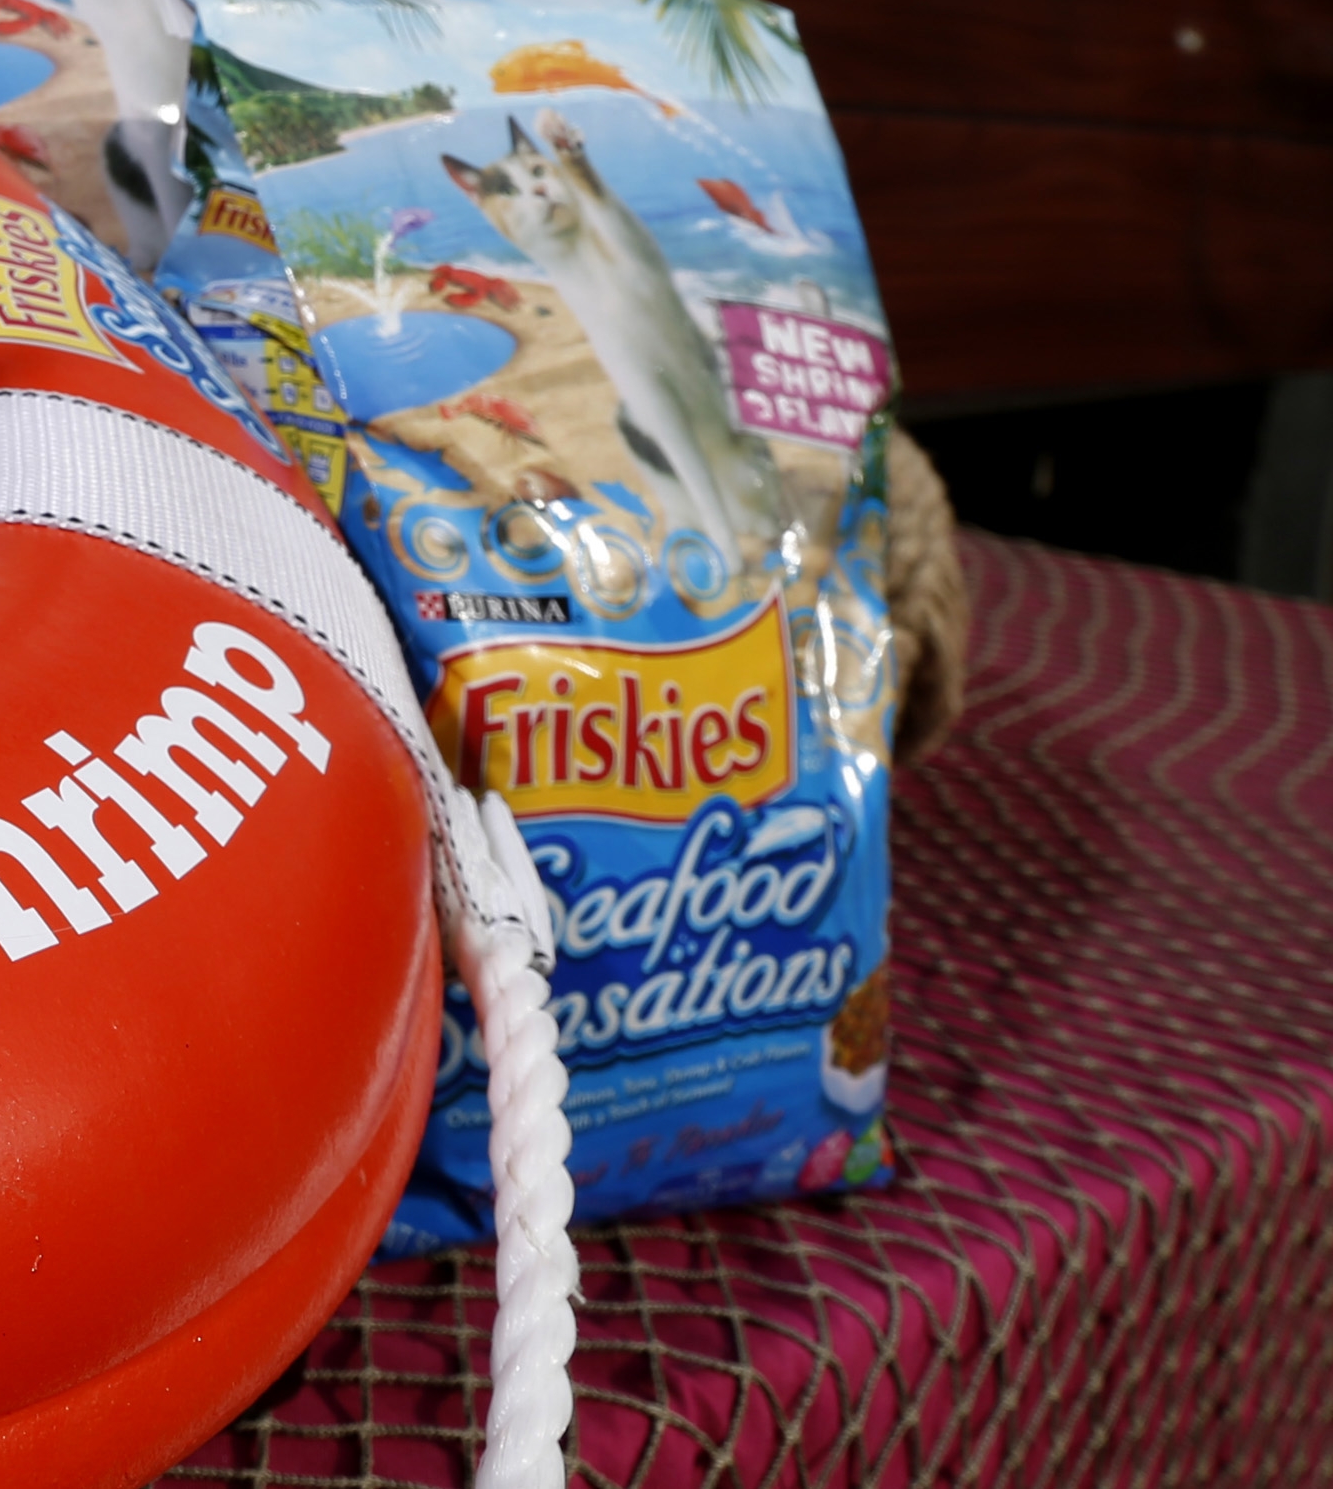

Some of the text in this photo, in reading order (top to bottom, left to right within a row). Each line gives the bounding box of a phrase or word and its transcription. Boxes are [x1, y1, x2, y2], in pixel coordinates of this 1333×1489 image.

[757, 311, 875, 376] NEW
[447, 592, 567, 623] PURINA
[460, 673, 771, 792] Friskies
[539, 807, 837, 973] Seafood
[441, 926, 852, 1080] nsations
